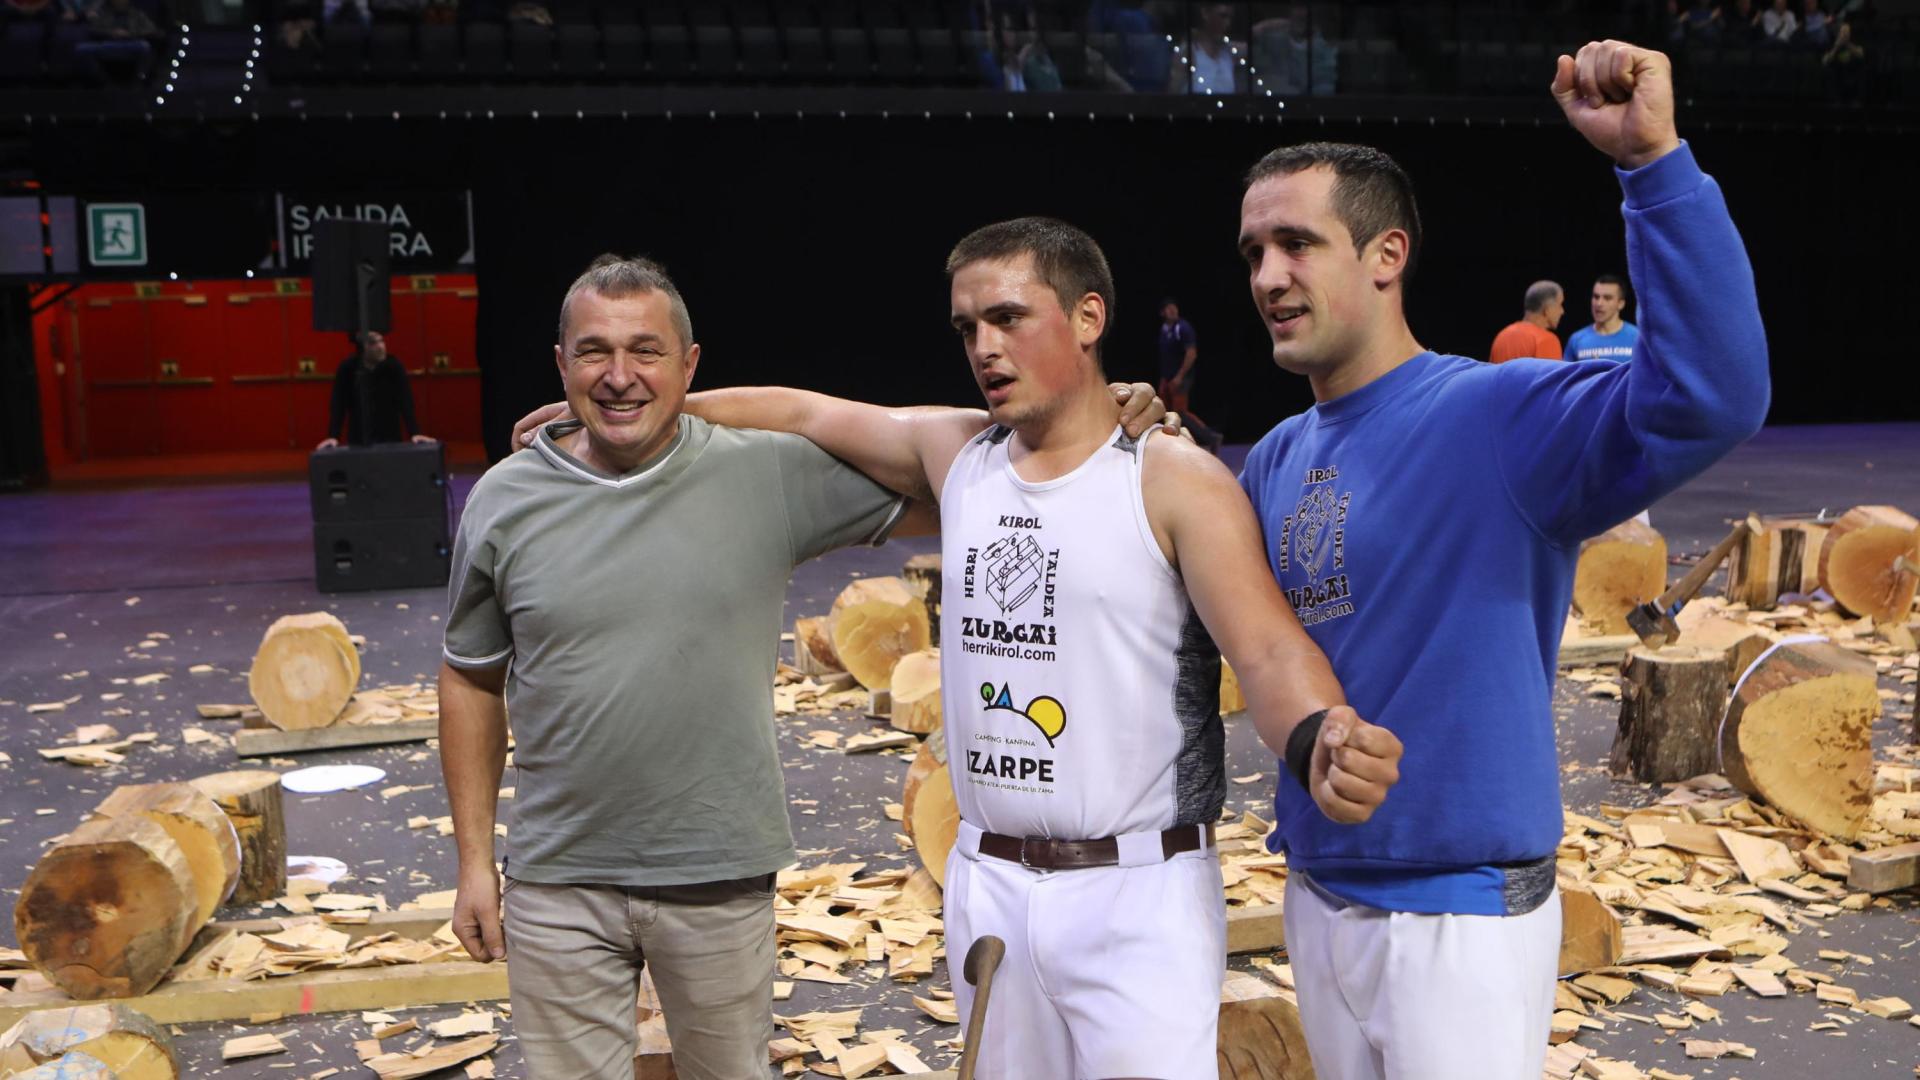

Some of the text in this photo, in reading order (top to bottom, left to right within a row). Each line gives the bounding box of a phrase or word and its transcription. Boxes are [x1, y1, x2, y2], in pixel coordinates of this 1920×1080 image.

[1304, 465, 1338, 484] IROL
[998, 515, 1042, 529] KIROL
[1334, 492, 1351, 569] TALDEA
[964, 547, 978, 598] HERRI
[1043, 548, 1060, 618] TALDEA
[962, 639, 1056, 662] herrikirol.com
[975, 733, 1036, 747] CAMPING KANPINA
[966, 749, 1054, 783] IZARPE
